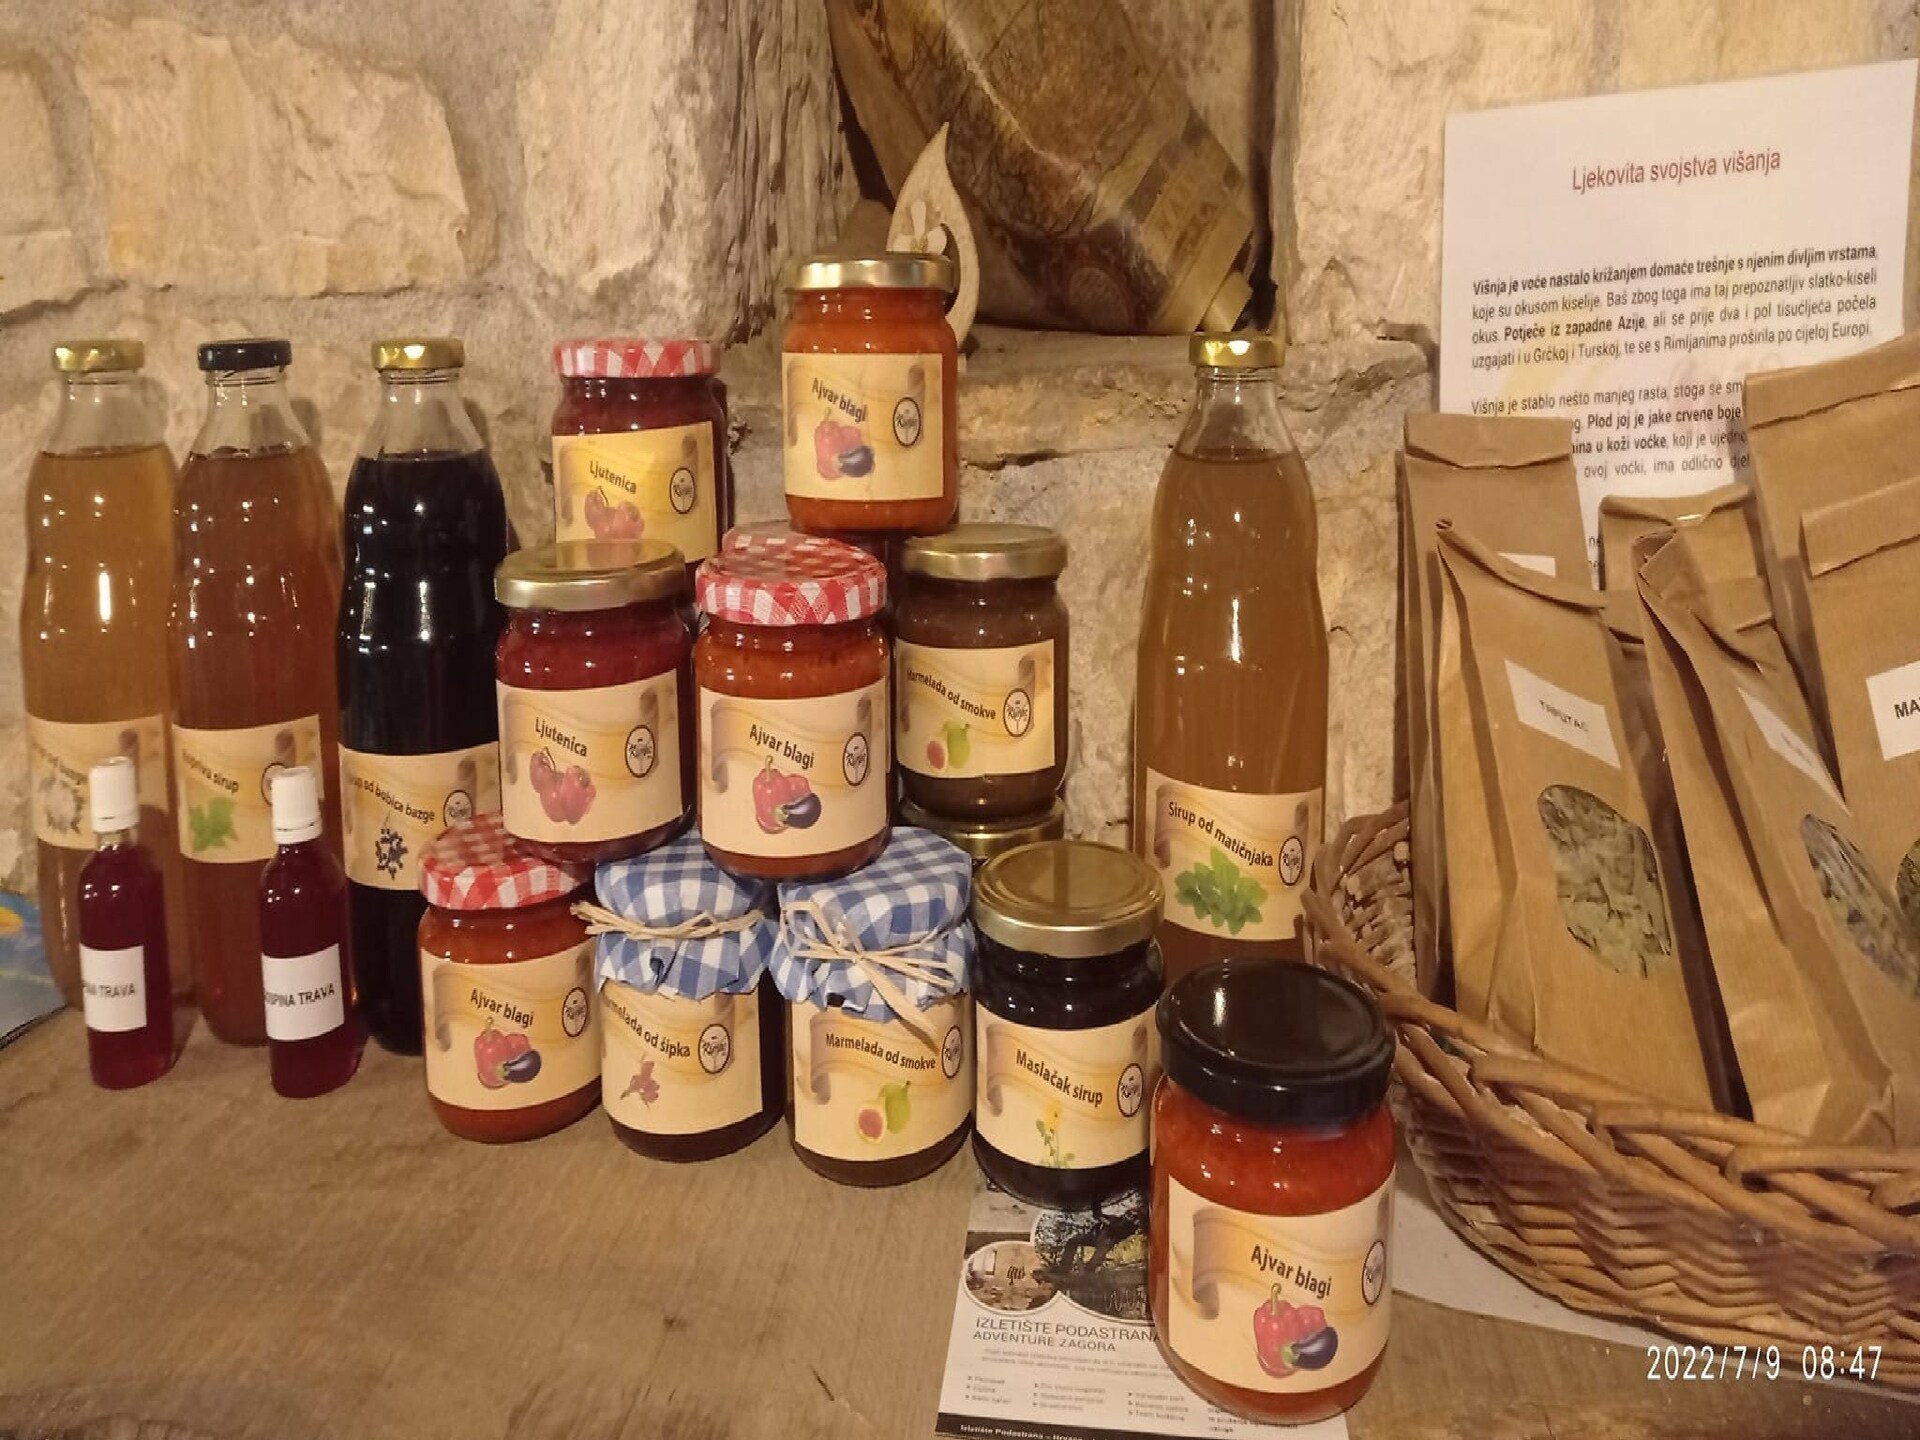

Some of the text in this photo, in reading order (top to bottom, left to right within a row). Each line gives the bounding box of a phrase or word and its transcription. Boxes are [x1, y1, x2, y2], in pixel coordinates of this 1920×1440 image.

[1572, 147, 1780, 195] Ljekovita svojstva višanja
[1473, 278, 1507, 297] Višnja
[1509, 278, 1519, 295] je
[1550, 268, 1590, 288] nastalo
[1593, 263, 1647, 285] križanjem
[1696, 255, 1735, 275] trešnje
[1737, 260, 1744, 270] s
[1746, 253, 1784, 273] njenim
[1787, 248, 1825, 269] divljim
[1472, 304, 1495, 322] koje
[1498, 306, 1511, 317] su
[1514, 298, 1559, 317] okusom
[1606, 290, 1628, 307] Baš
[1631, 288, 1658, 307] zbog
[1662, 285, 1686, 304] toga
[1690, 283, 1710, 298] ima
[1714, 283, 1728, 300] taj
[1731, 275, 1805, 299] prepoznatljiv
[1808, 267, 1877, 289] slatko-kiseli
[1504, 324, 1546, 344] Potječe
[1550, 321, 1560, 336] iz
[1565, 317, 1612, 338] zapadne
[1653, 311, 1666, 327] ali
[1671, 312, 1685, 325] se
[1690, 309, 1714, 328] prije
[1720, 306, 1739, 322] dva
[1754, 303, 1772, 322] pol
[1837, 294, 1876, 314] počela
[1472, 351, 1515, 371] uzgajati
[1523, 352, 1531, 364] u
[1624, 340, 1635, 355] te
[1638, 341, 1650, 354] se
[1654, 340, 1661, 351] s
[1664, 332, 1726, 353] Rimljanima
[1729, 328, 1775, 348] proširila
[1778, 330, 1792, 345] po
[1795, 323, 1829, 343] cijeloj
[811, 377, 839, 406] Ajvar
[839, 394, 868, 424] blagi
[1471, 397, 1504, 415] Višnja
[1508, 396, 1518, 414] je
[1521, 390, 1555, 411] stablo
[1559, 391, 1590, 408] nešto
[1593, 387, 1635, 406] manjeg
[1673, 383, 1705, 400] stoga
[1709, 383, 1723, 396] se
[1587, 413, 1613, 429] Plod
[1616, 412, 1630, 430] joj
[1633, 411, 1644, 429] je
[1675, 408, 1713, 423] crvene
[1717, 404, 1741, 422] boje
[1596, 442, 1603, 453] u
[1606, 436, 1630, 452] koži
[1672, 430, 1693, 448] koji
[1696, 431, 1707, 448] je
[588, 459, 637, 496] Ljutenica
[1584, 464, 1608, 481] ovoj
[1653, 459, 1674, 473] ima
[1681, 456, 1724, 473] odlično
[947, 690, 960, 705] od
[960, 699, 997, 721] smokve
[535, 717, 588, 757] Ljutenica
[750, 723, 782, 752] Ajvar
[783, 740, 815, 770] blagi
[1168, 801, 1197, 826] Sirup
[1198, 815, 1214, 835] od
[1214, 828, 1274, 867] matičnjaka
[298, 982, 335, 1005] TRAVA
[470, 988, 502, 1014] Ajvar
[503, 1003, 534, 1030] blagi
[644, 1029, 659, 1049] od
[660, 1038, 692, 1060] šipka
[826, 1032, 937, 1071] Marmelada od smokve
[1016, 1049, 1071, 1096] Maslačak
[1072, 1084, 1104, 1109] sirup
[1250, 1243, 1294, 1281] Ajvar
[1294, 1265, 1333, 1301] blagi
[972, 1331, 1117, 1353] ADVENTURE ZAGORA
[975, 1316, 1052, 1335] IZLETIŠTE
